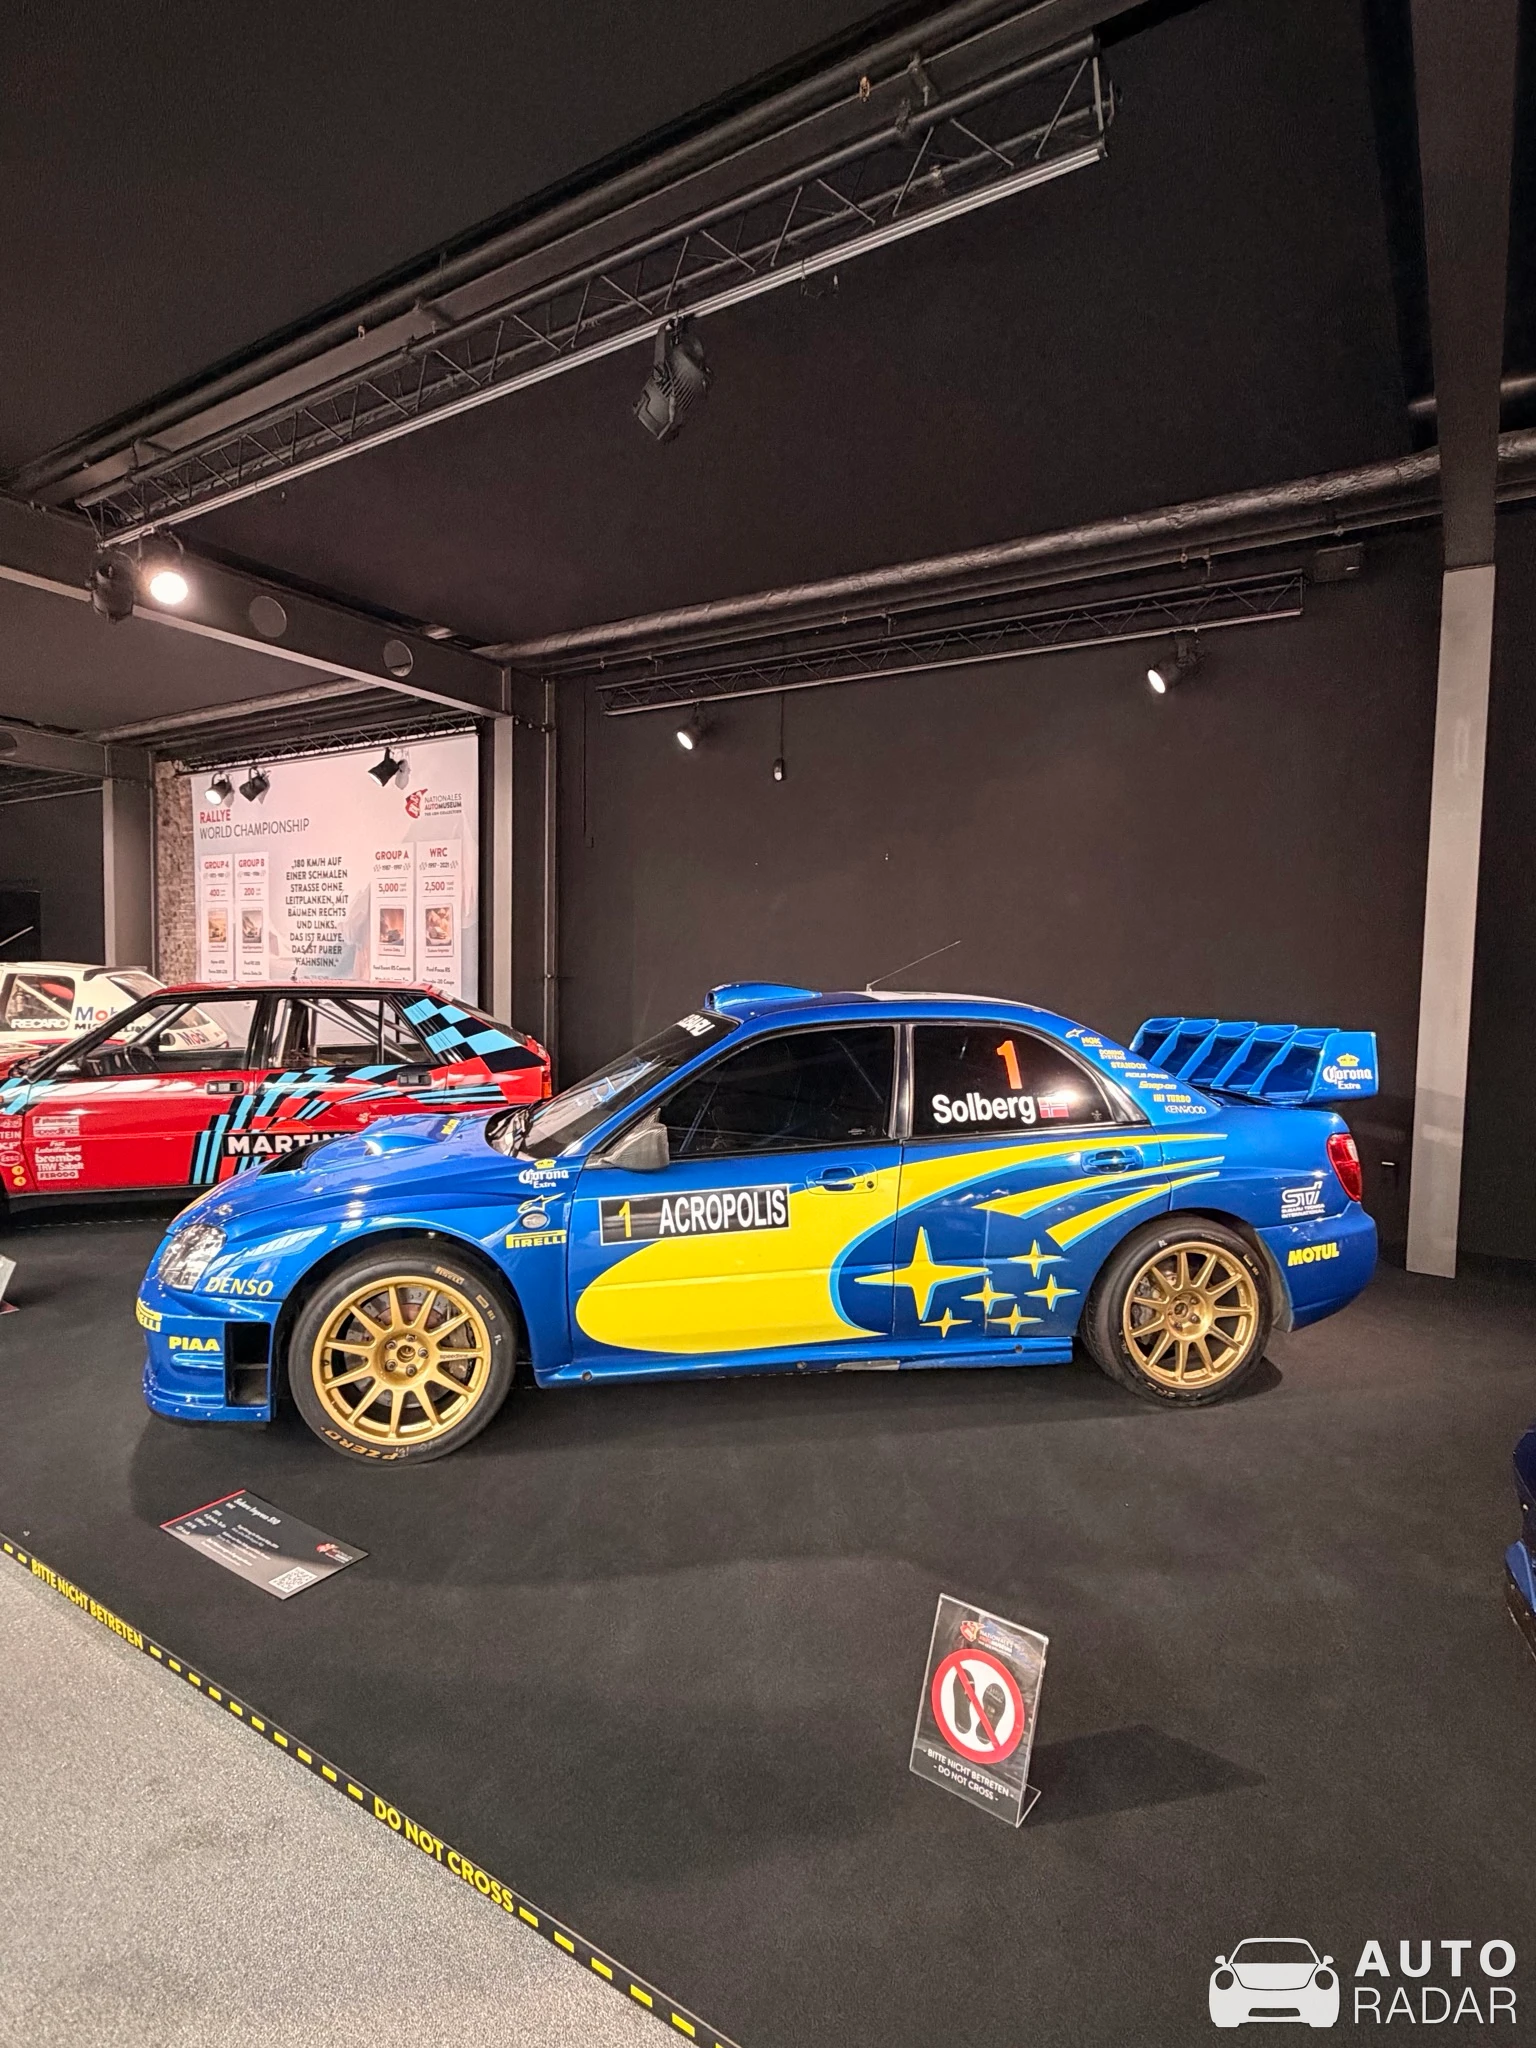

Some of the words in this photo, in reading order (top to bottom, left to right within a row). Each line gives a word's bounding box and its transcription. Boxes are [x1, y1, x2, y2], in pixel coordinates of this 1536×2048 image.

[425, 794, 462, 803] NATIONALES
[425, 802, 462, 811] AUTOMUSEUM
[200, 810, 231, 824] RALLYE
[200, 825, 232, 840] WORLD
[234, 818, 310, 837] CHAMPIONSHIP
[375, 851, 402, 860] GROUP
[403, 850, 409, 859] A
[430, 847, 448, 858] WRC
[204, 861, 224, 870] GROUP
[238, 860, 259, 868] GROUP
[306, 858, 326, 868] KM/H
[327, 857, 342, 866] AUF
[286, 871, 307, 880] EINER
[308, 869, 348, 879] SCHMALEN
[290, 883, 320, 892] STRASSE
[321, 882, 343, 892] OHNE
[378, 883, 399, 894] 5,000
[425, 882, 446, 893] 2,500
[285, 895, 334, 905] LEITPLANKEN,
[335, 895, 349, 904] MIT
[288, 906, 317, 917] BÄUMEN
[319, 907, 346, 917] RECHTS
[296, 920, 312, 929] UND
[314, 920, 337, 930] LINKS.
[290, 933, 304, 941] DAS
[305, 933, 315, 942] IST
[292, 945, 306, 954] DAS
[319, 946, 342, 954] PURER
[11, 1018, 69, 1030] RECARO
[996, 1040, 1023, 1090] 1
[1110, 1061, 1148, 1070] STANDOX
[1322, 1065, 1373, 1085] Corona
[1138, 1080, 1177, 1090] Snap-on
[1337, 1080, 1362, 1090] Extra
[1166, 1094, 1192, 1103] TURBO
[932, 1091, 1037, 1125] Solberg
[1164, 1104, 1207, 1115] KENWOOD
[35, 1152, 82, 1164] brembo
[37, 1162, 57, 1172] TRW
[519, 1168, 569, 1185] Corona
[533, 1181, 557, 1189] Extra
[618, 1200, 632, 1238] 1
[658, 1190, 787, 1235] ACROPOLIS
[506, 1229, 567, 1249] PIRELLI
[1287, 1242, 1340, 1267] MOTUL
[434, 1266, 465, 1285] PIRELLI
[205, 1277, 274, 1297] DENSO
[168, 1336, 220, 1352] PIAA
[31, 1558, 57, 1589] BITTE
[58, 1577, 88, 1611] NICHT
[90, 1599, 143, 1650] BETRETEN
[928, 1748, 947, 1764] BITTE
[947, 1758, 971, 1777] NICHT
[971, 1770, 1010, 1797] BETRETEN
[938, 1765, 950, 1777] DO
[951, 1771, 968, 1786] NOT
[967, 1780, 994, 1801] CROSS
[374, 1796, 402, 1831] DO
[405, 1818, 444, 1863] NOT
[447, 1851, 514, 1914] CROSS
